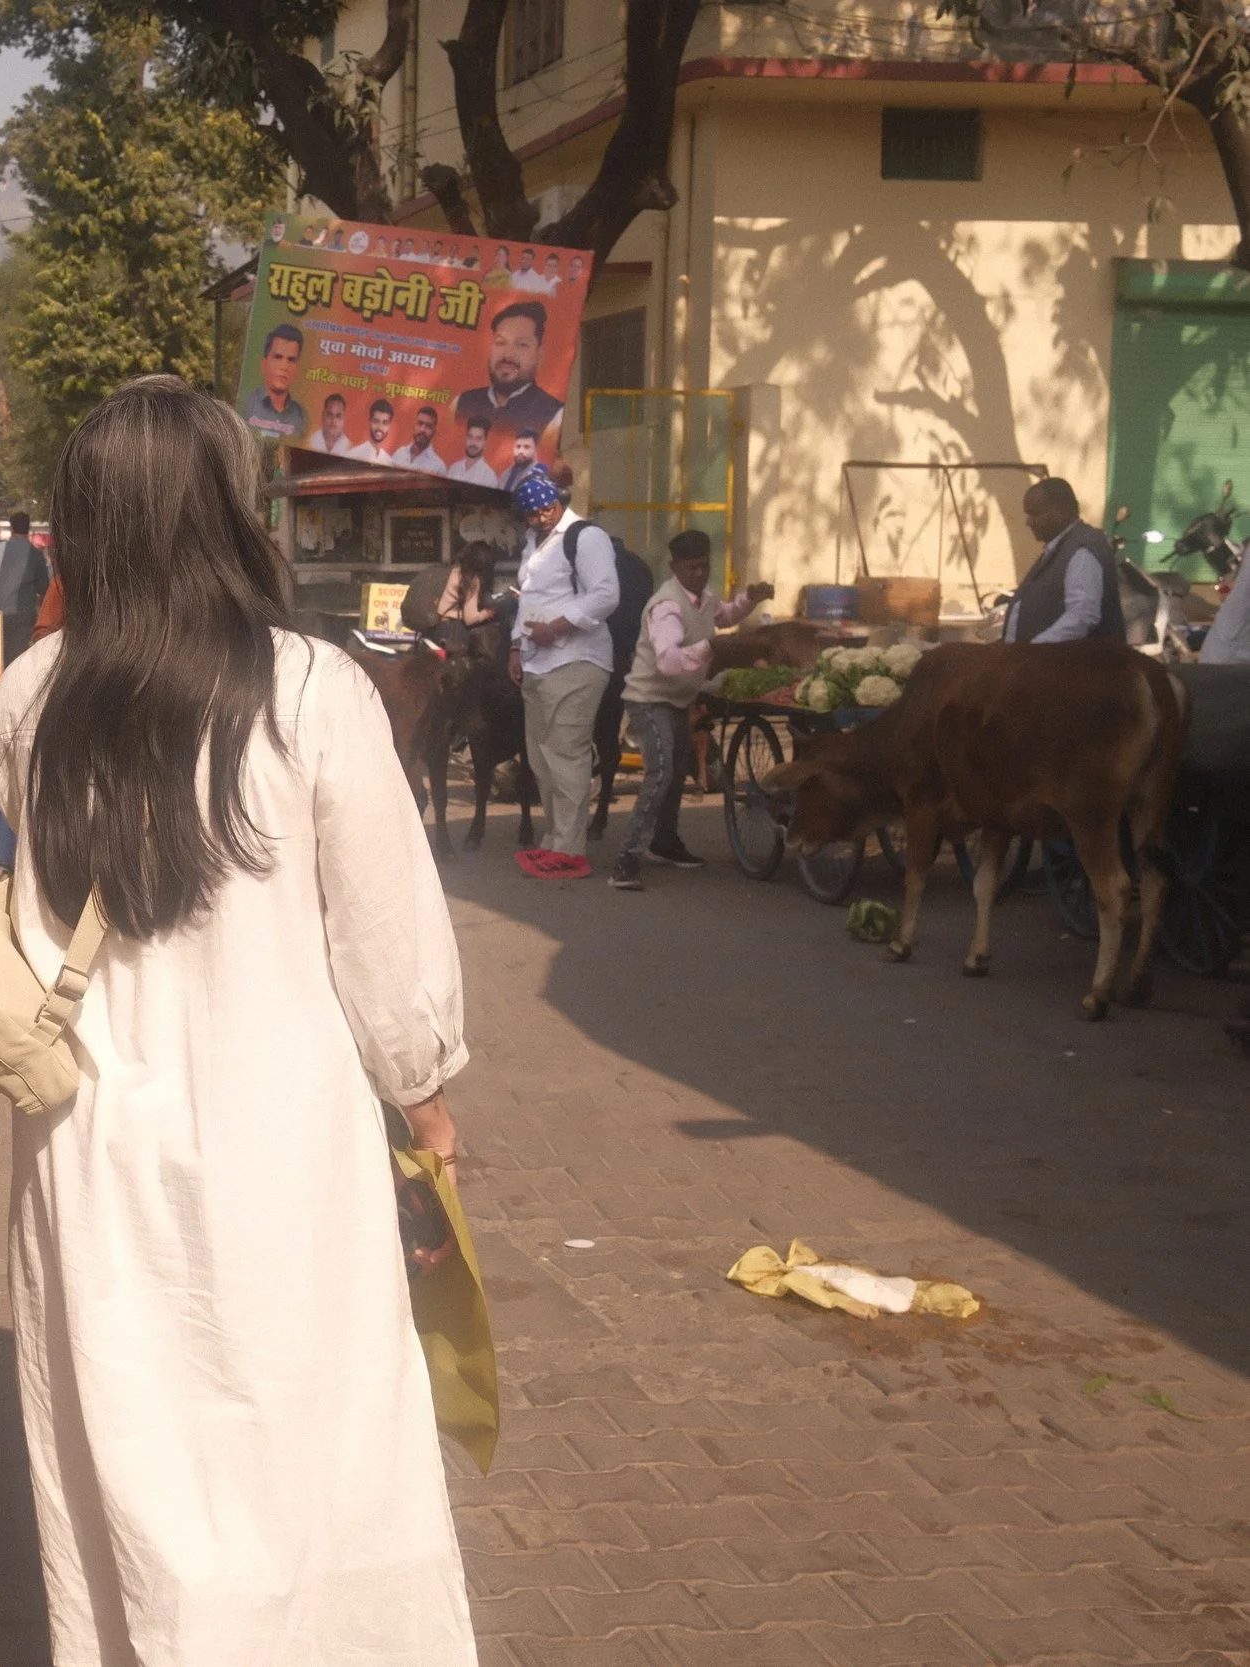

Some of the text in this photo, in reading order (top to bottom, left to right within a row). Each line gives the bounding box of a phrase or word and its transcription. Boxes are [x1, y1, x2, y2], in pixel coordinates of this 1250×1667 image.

[268, 262, 486, 330] राहुल बड़ोनी जी
[319, 338, 346, 356] युवा
[350, 340, 384, 361] मोर्चा
[387, 349, 438, 370] अध्यक्ष
